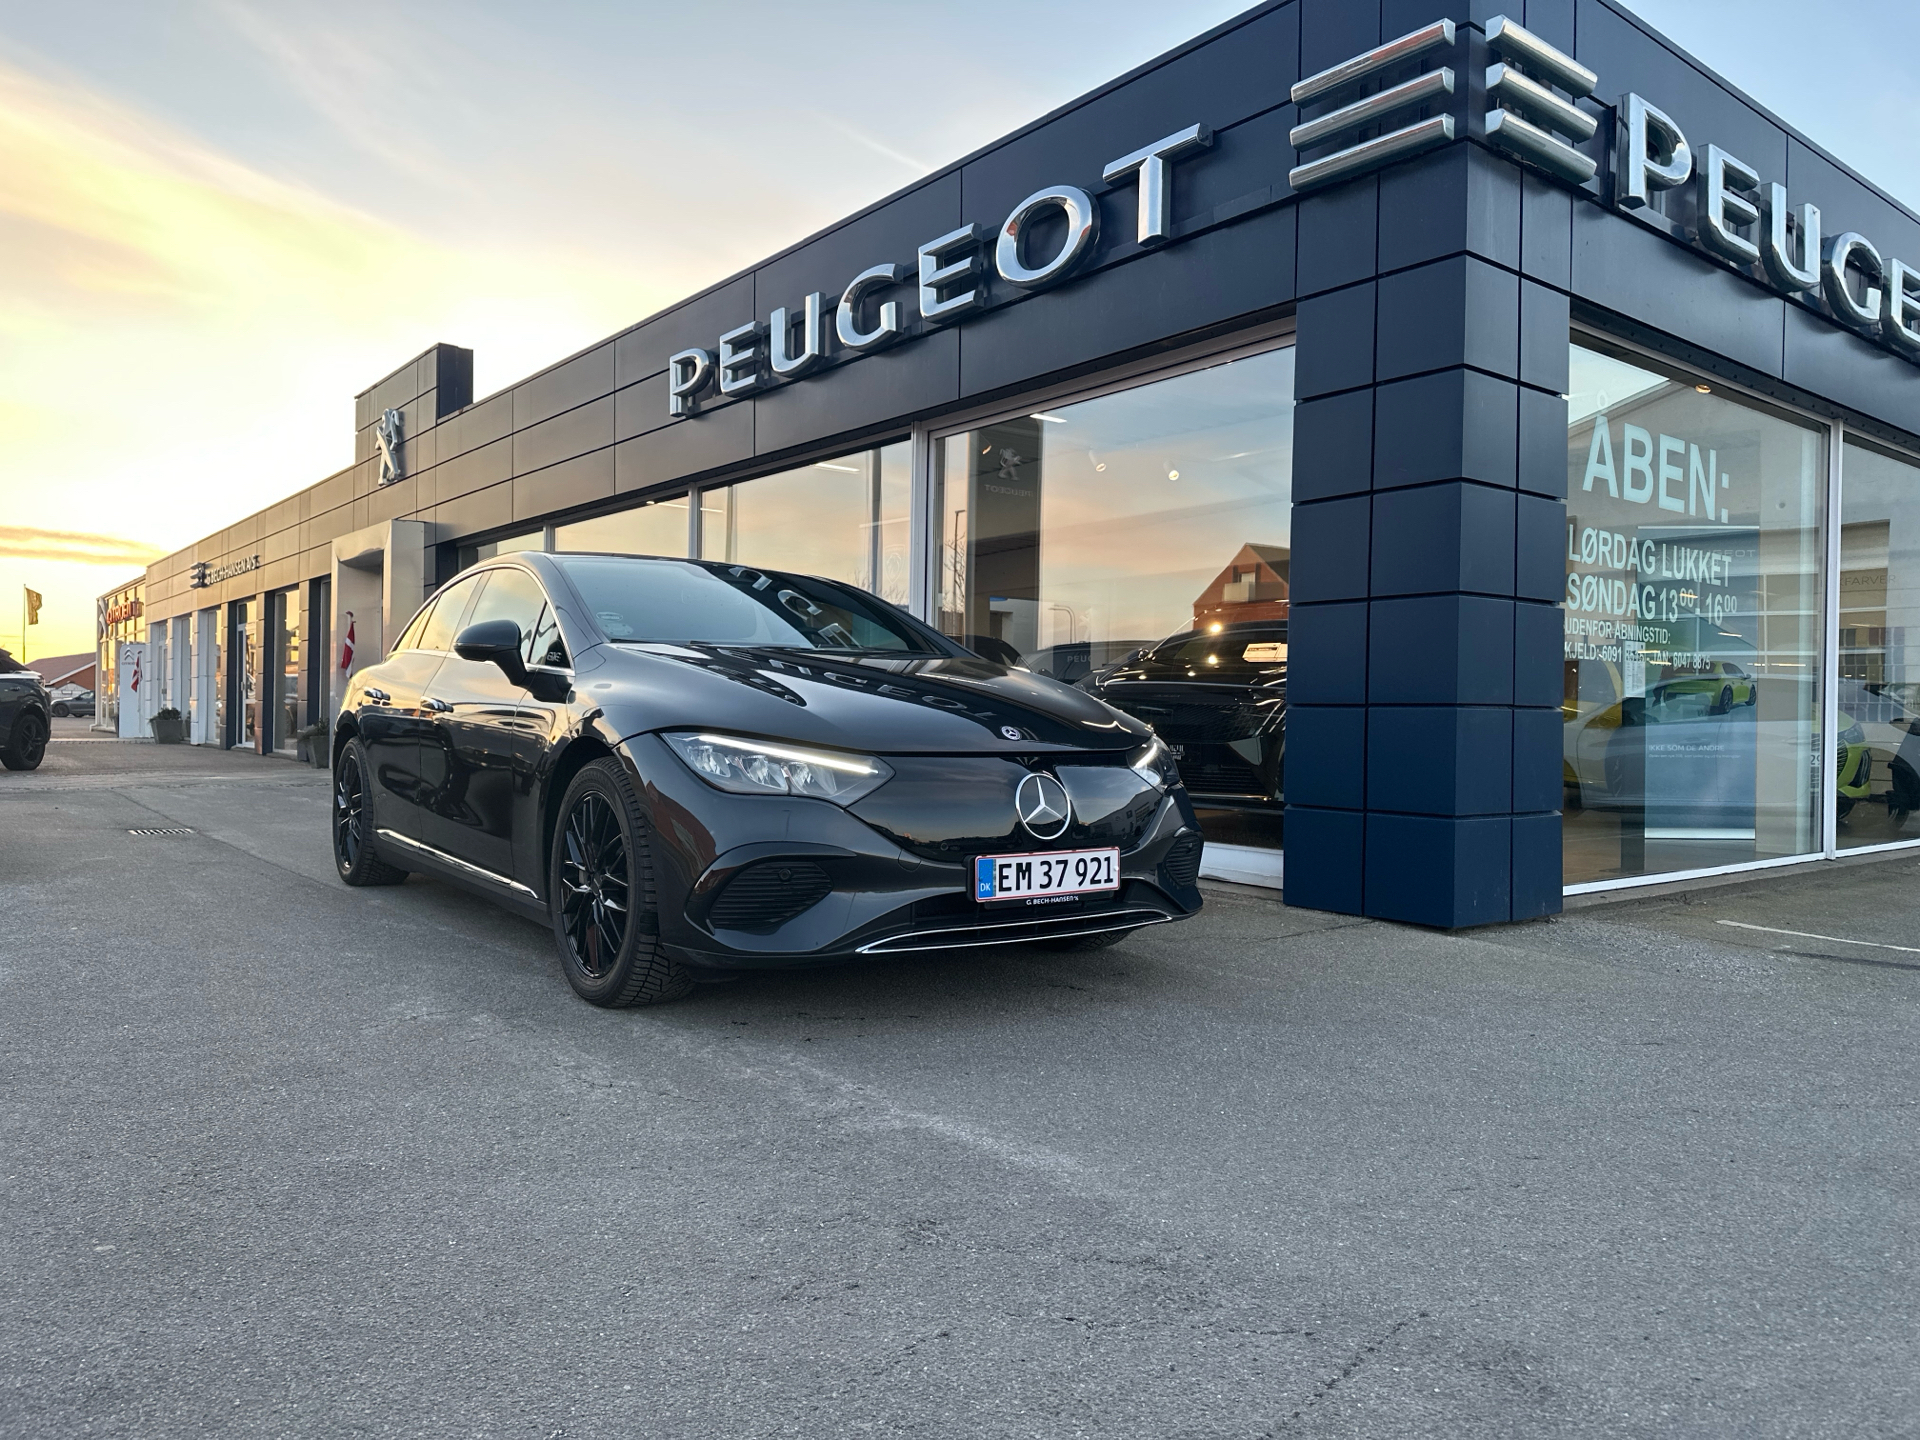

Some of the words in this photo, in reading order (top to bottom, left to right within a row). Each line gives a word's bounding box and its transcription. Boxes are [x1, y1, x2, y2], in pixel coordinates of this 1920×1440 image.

[669, 122, 1214, 417] PEUGEOT
[1582, 389, 1730, 524] ÅBEN:
[1568, 524, 1656, 575] LØRDAG
[1662, 543, 1732, 587] LUKKET
[1567, 572, 1656, 620] SØNDAG
[1565, 617, 1613, 638] UDENFOR
[1565, 641, 1600, 661] KJELD:
[1602, 645, 1622, 663] 6091
[1673, 651, 1691, 668] 6047
[1692, 653, 1711, 670] 8875
[1667, 744, 1685, 752] SOM
[980, 882, 991, 892] DK
[998, 862, 1032, 892] EM
[1039, 859, 1068, 889] 37
[1075, 856, 1113, 887] 921
